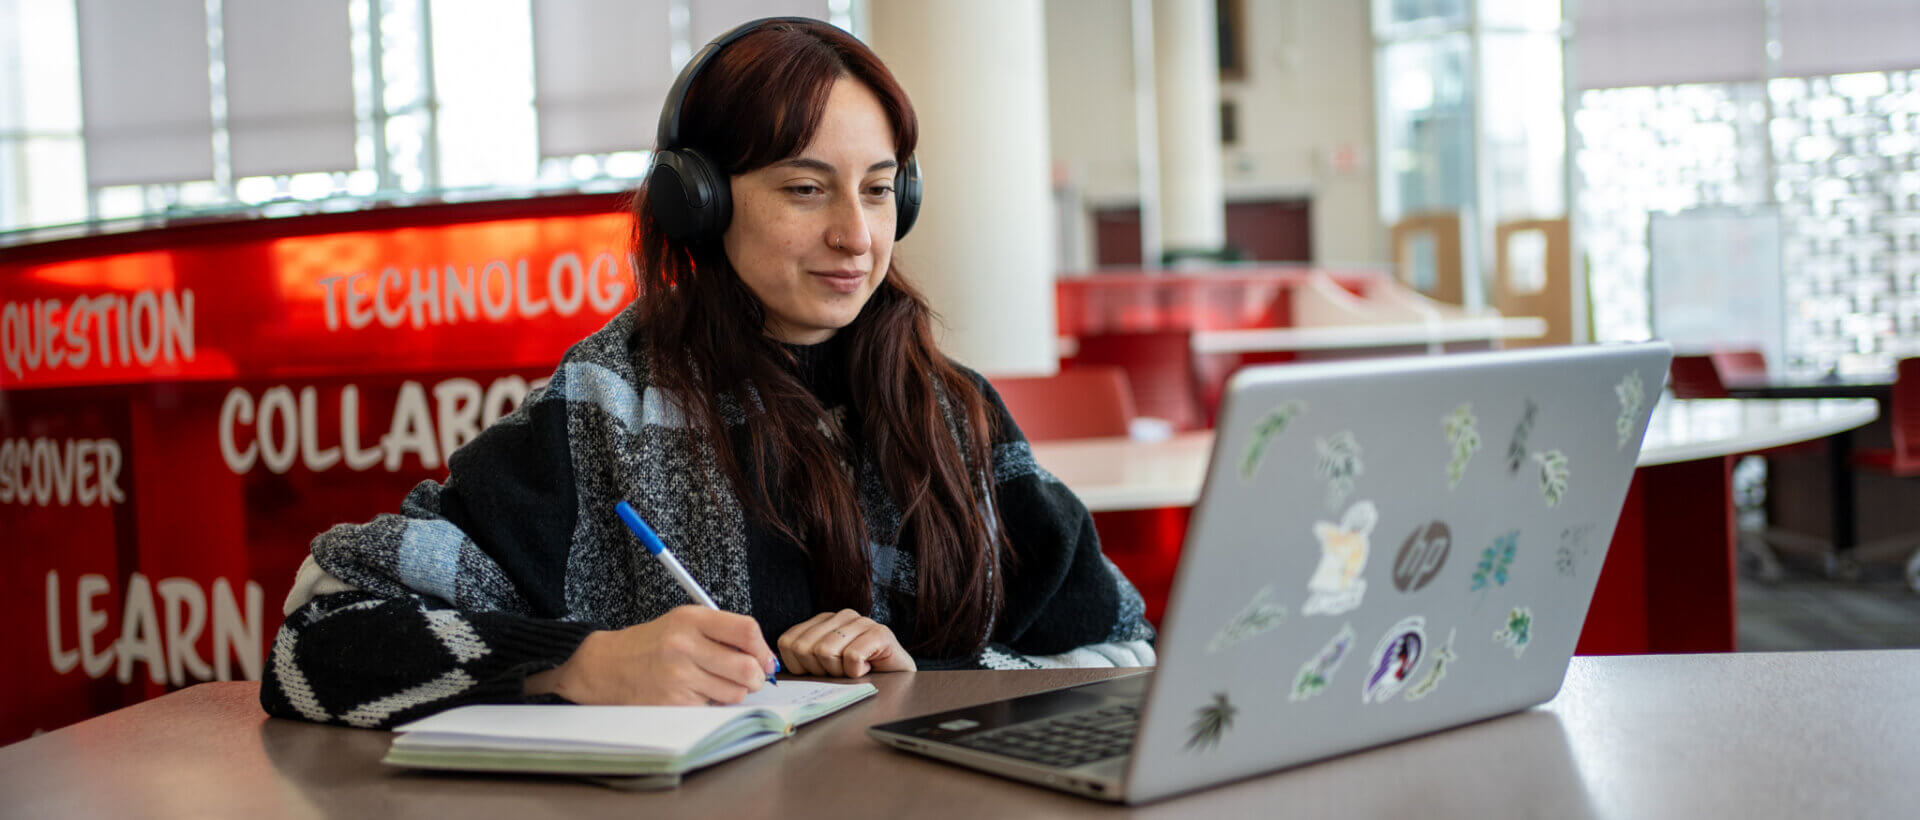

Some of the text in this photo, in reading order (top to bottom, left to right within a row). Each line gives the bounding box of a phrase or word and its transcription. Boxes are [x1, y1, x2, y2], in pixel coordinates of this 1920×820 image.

[1, 287, 196, 381] QUESTION
[218, 374, 552, 475] COLLABO
[1394, 521, 1452, 591] hp
[45, 569, 264, 686] LEARN
